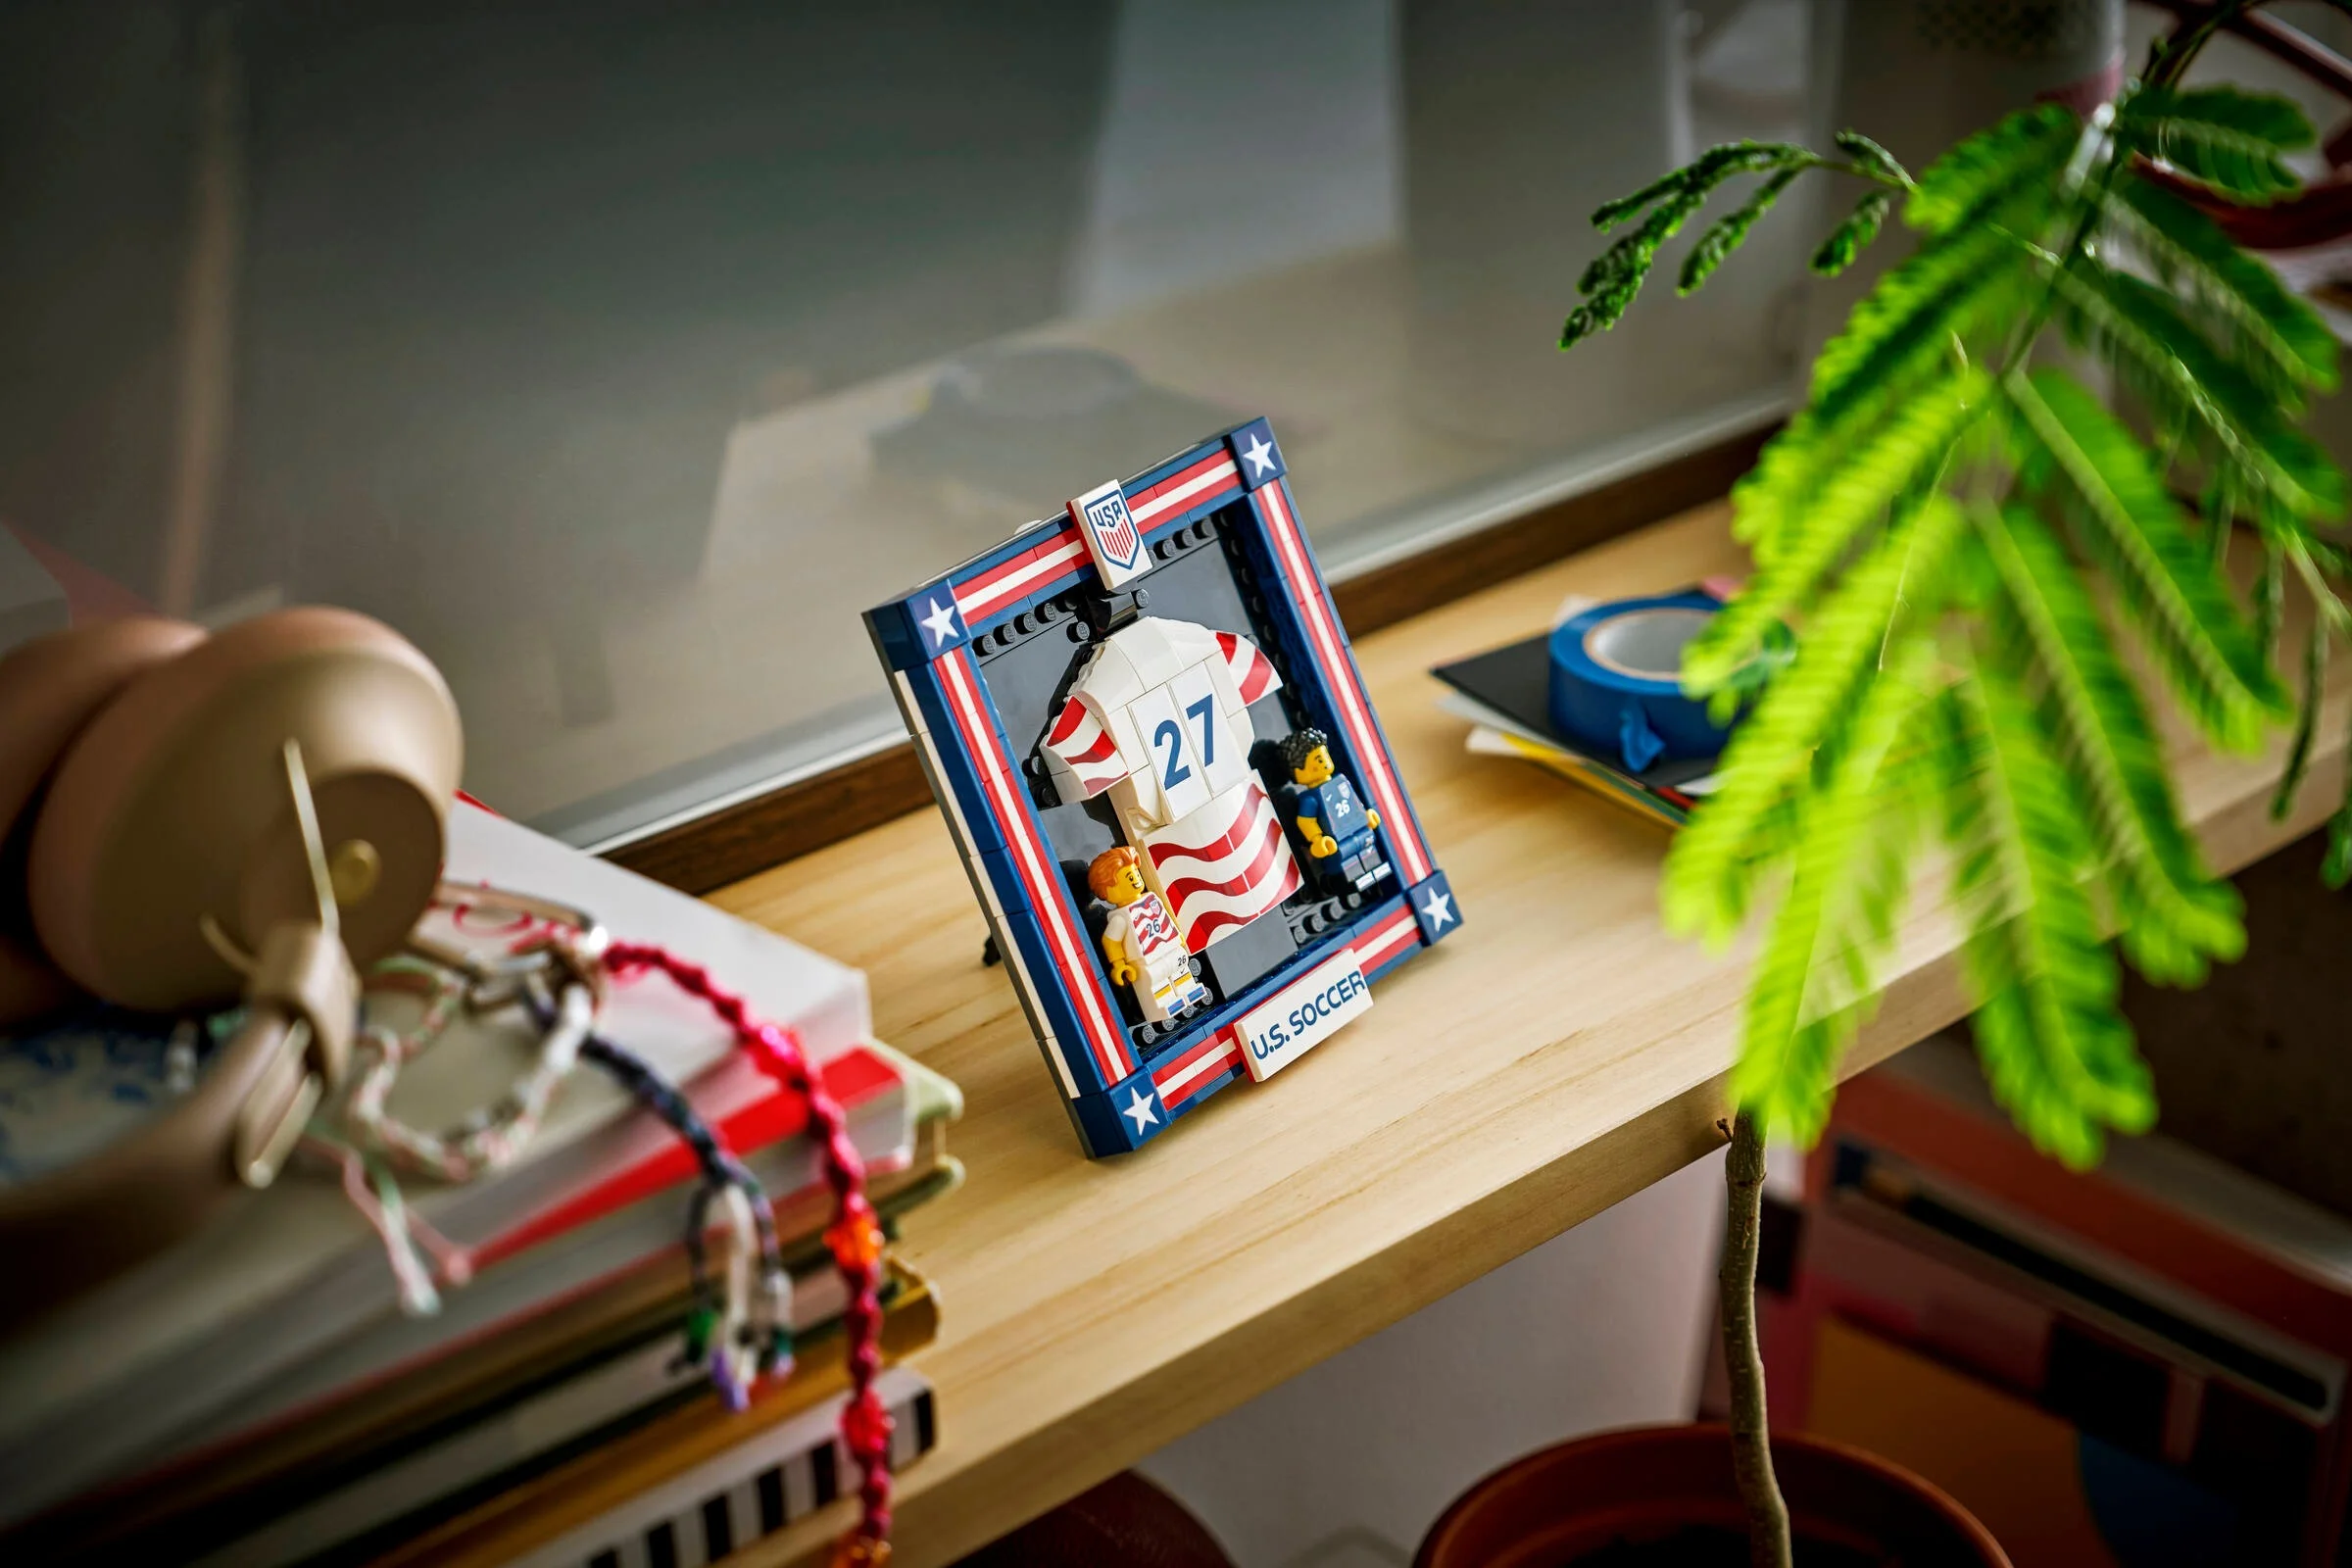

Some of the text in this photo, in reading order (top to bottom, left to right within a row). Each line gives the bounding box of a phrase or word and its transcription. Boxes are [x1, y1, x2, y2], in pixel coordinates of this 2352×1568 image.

[1093, 501, 1122, 528] USA
[1154, 693, 1214, 791] 27
[1335, 800, 1350, 818] 26
[1146, 918, 1161, 938] 26
[1177, 955, 1187, 967] 26
[1250, 970, 1366, 1059] U.S. SOCCER
